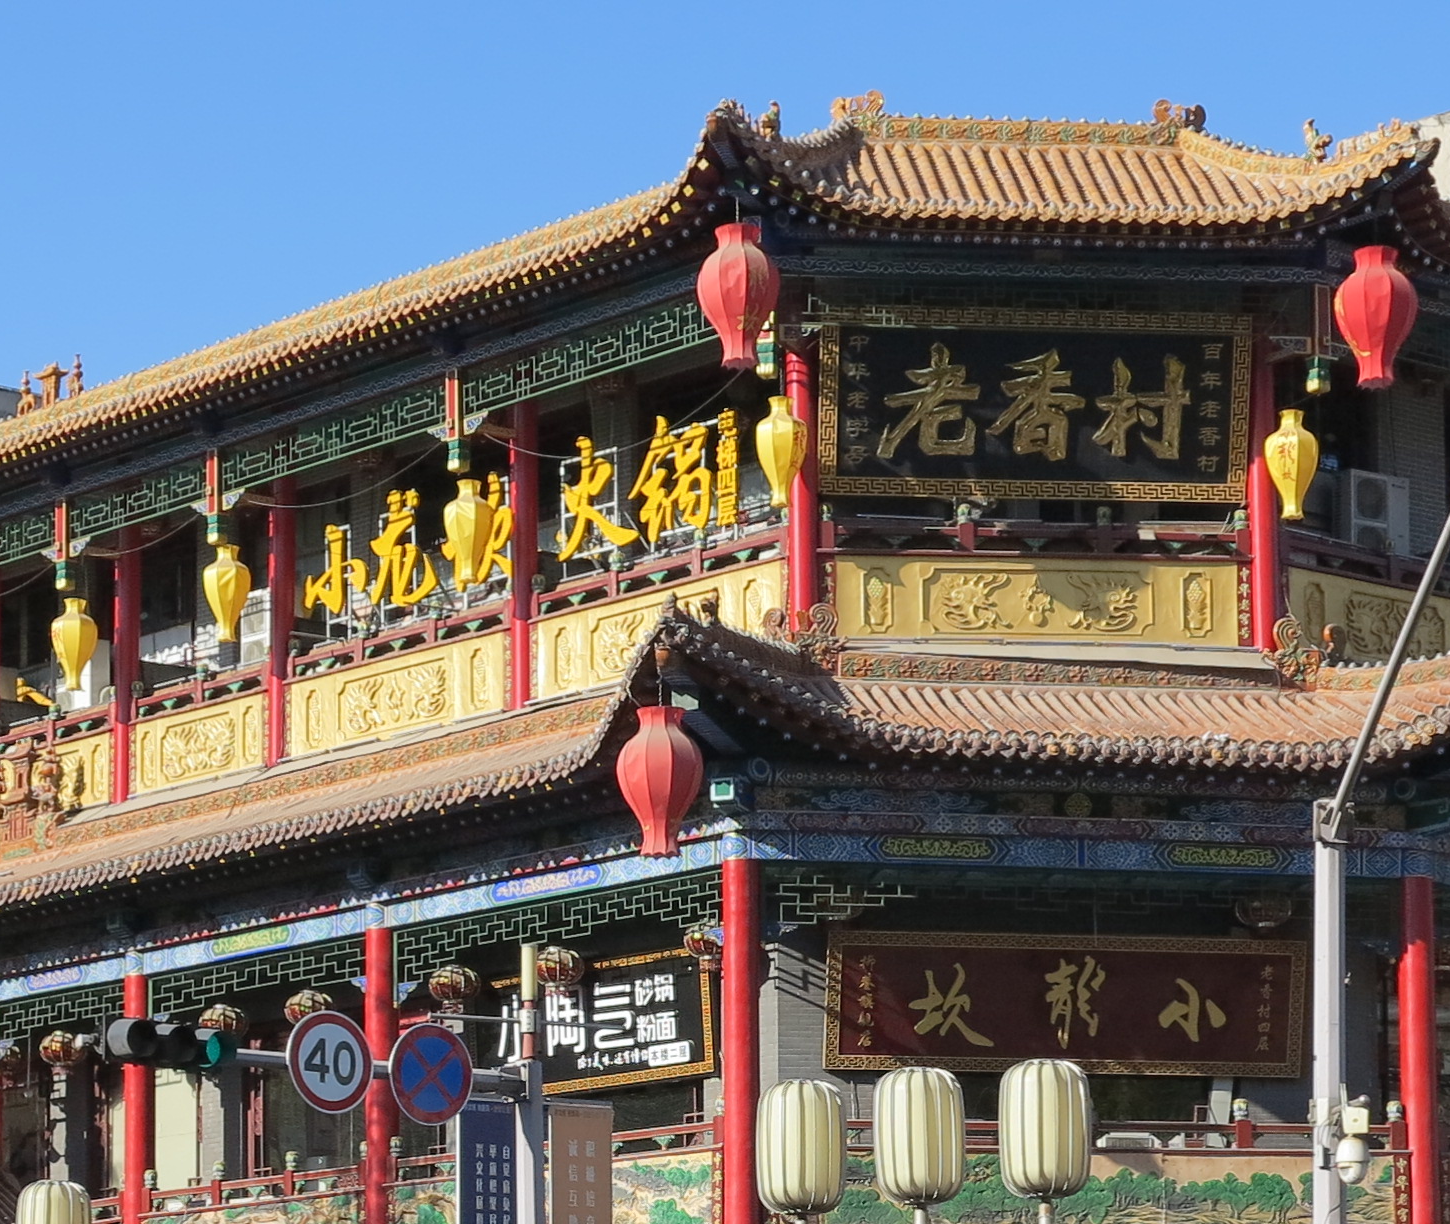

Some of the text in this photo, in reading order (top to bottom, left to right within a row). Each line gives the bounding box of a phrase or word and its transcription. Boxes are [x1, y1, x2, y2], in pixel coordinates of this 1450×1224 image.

[877, 343, 1191, 461] 老香村
[1197, 343, 1224, 473] 百年老香村
[716, 408, 739, 527] 电梯四层
[634, 974, 675, 1006] 砂锅
[636, 1011, 678, 1043] 粉面
[304, 1037, 357, 1087] 40
